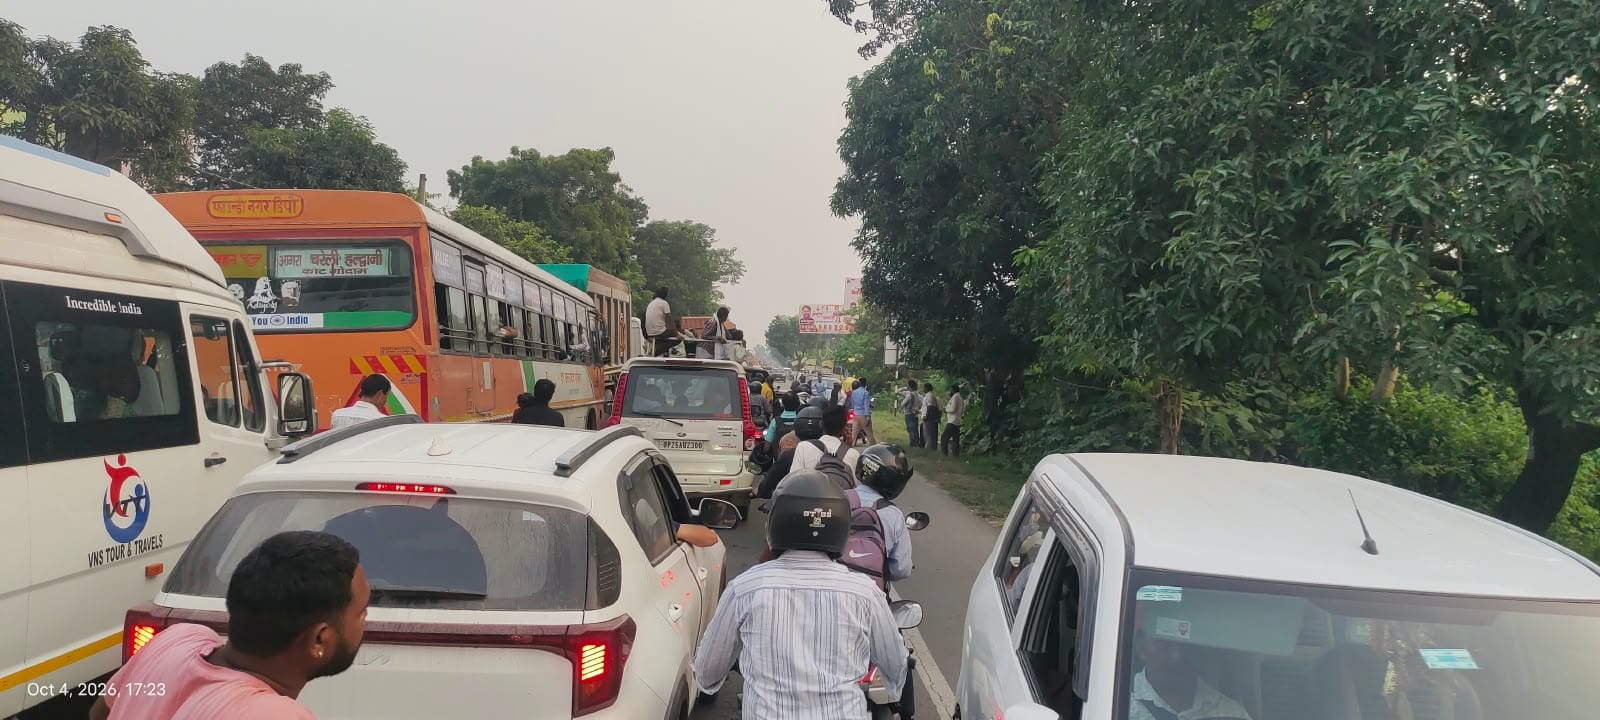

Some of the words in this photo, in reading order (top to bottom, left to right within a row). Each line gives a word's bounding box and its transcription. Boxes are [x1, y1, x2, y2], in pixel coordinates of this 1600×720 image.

[247, 199, 272, 215] नगर
[278, 254, 302, 267] आगरा
[309, 249, 340, 268] बरेली
[65, 295, 116, 313] Incredible
[251, 316, 268, 326] You
[283, 315, 309, 325] India
[88, 550, 104, 569] VNS
[105, 543, 126, 563] TOUR
[127, 541, 133, 558] &
[134, 533, 163, 555] TRAVELS
